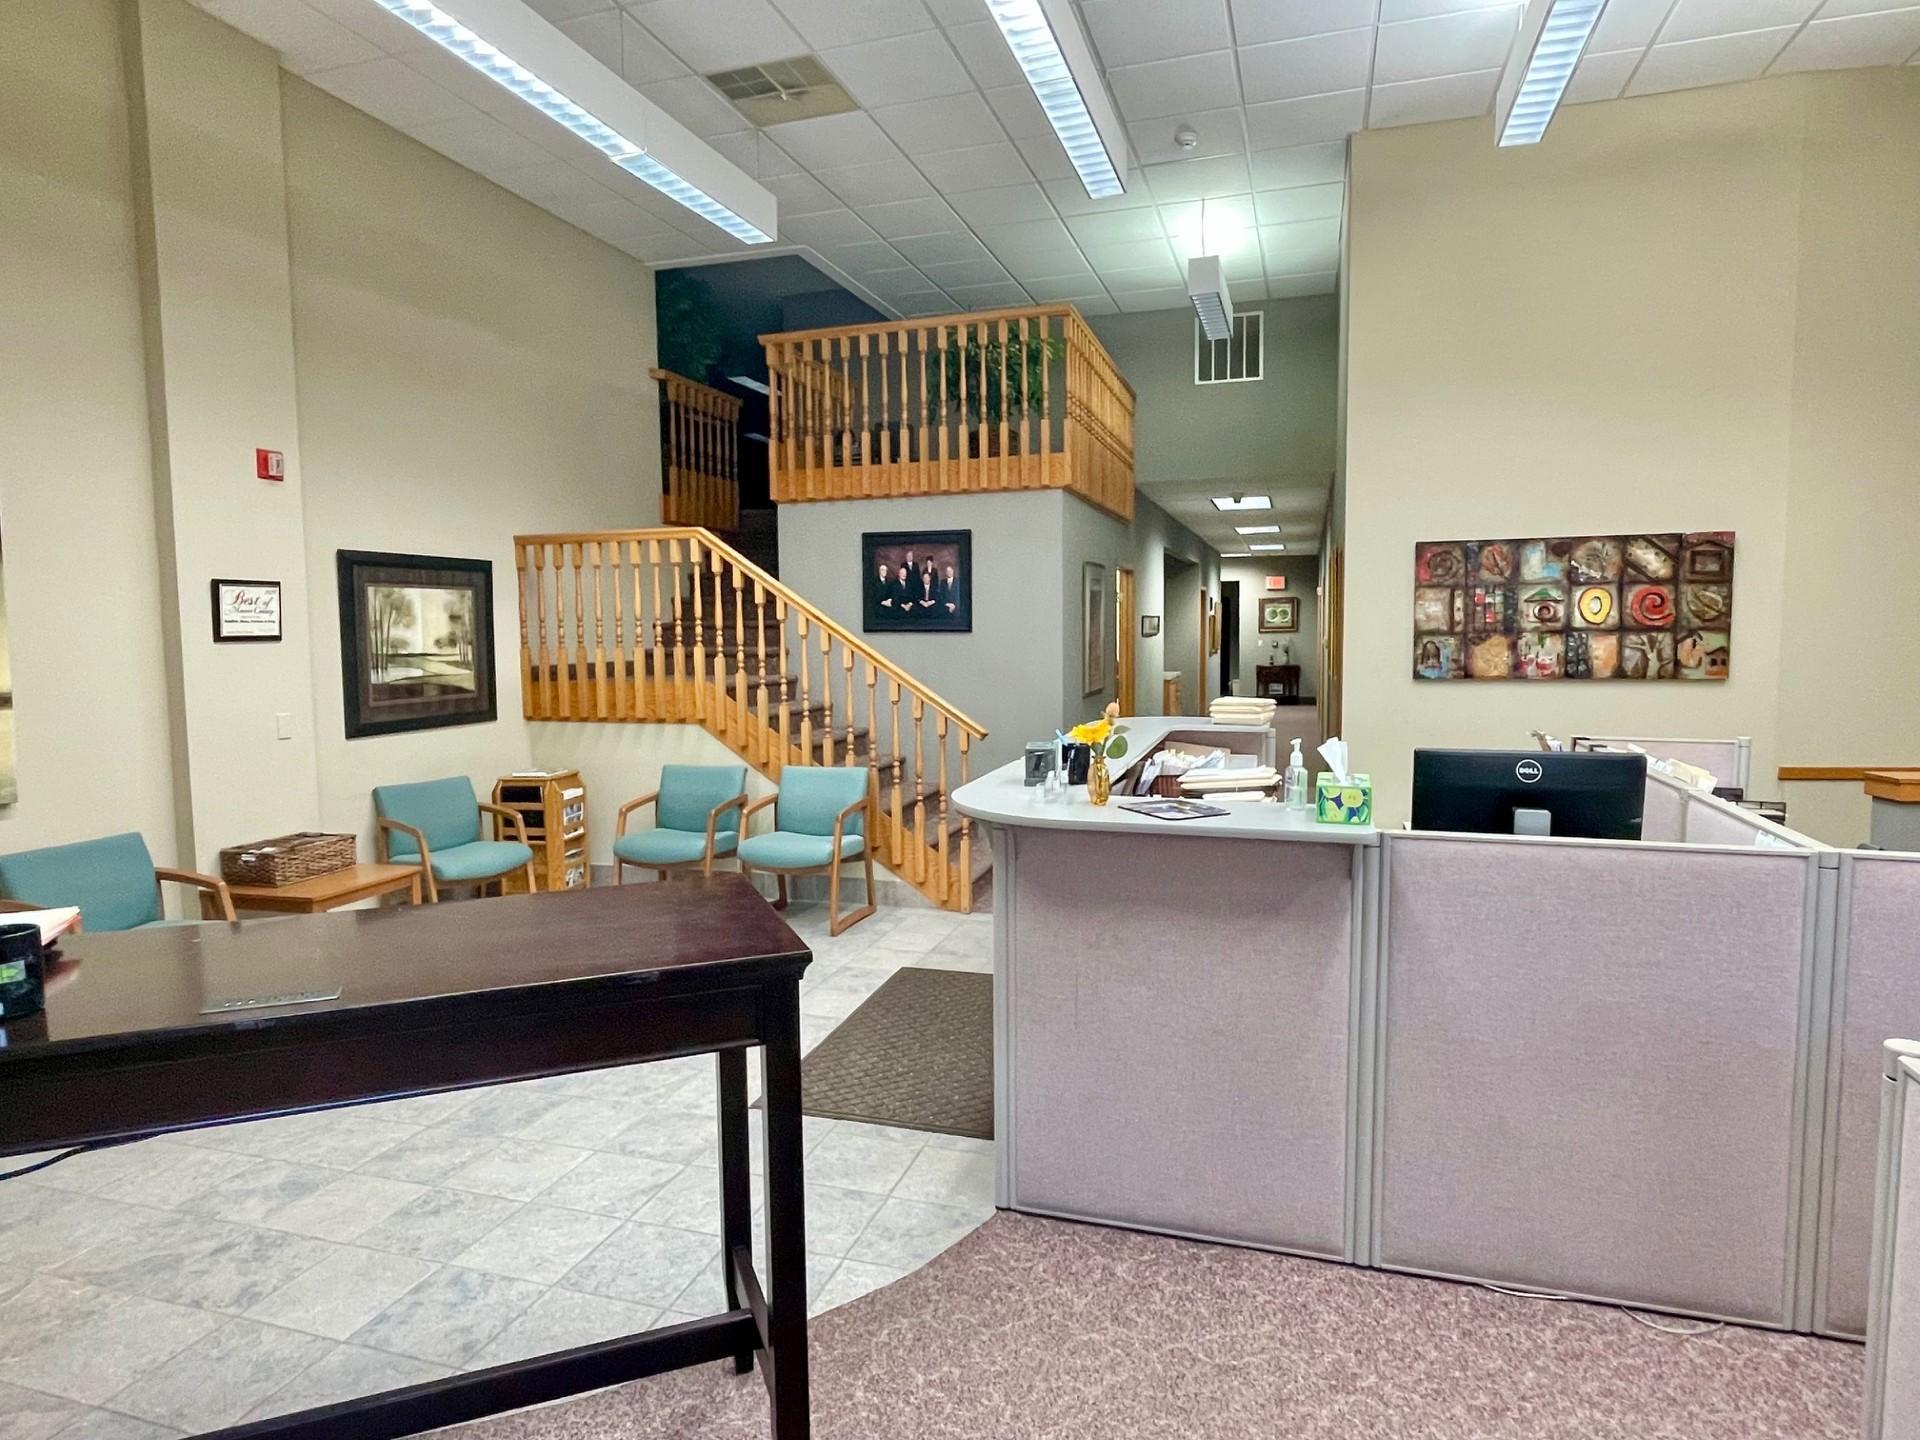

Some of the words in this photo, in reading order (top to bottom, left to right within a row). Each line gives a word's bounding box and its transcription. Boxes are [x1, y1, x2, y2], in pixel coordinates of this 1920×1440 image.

[233, 590, 260, 606] Best
[262, 597, 274, 609] of
[1519, 767, 1539, 775] DELL
